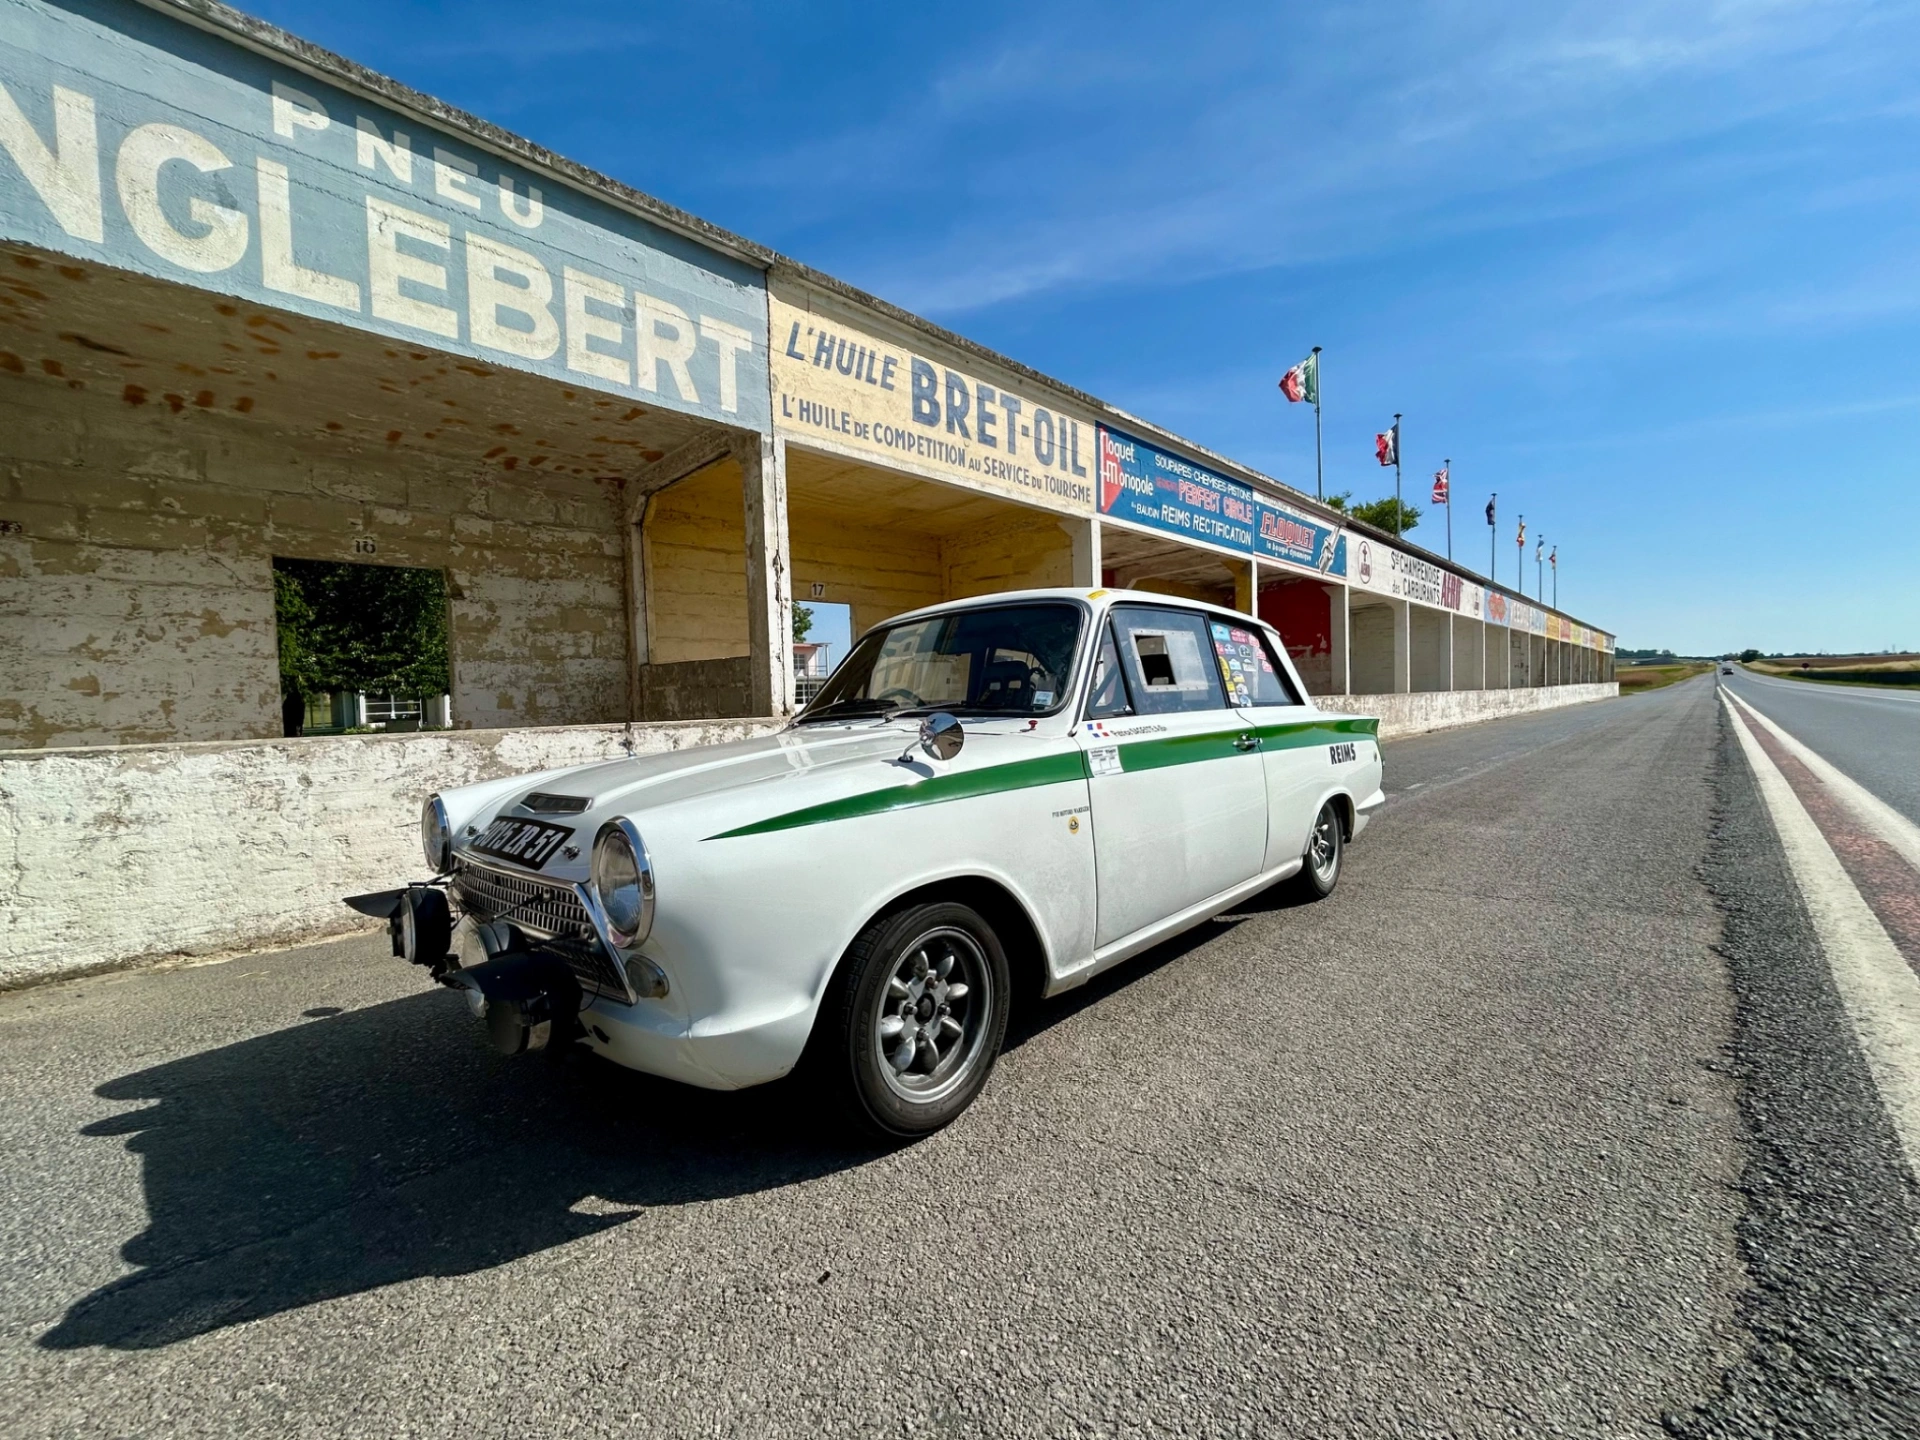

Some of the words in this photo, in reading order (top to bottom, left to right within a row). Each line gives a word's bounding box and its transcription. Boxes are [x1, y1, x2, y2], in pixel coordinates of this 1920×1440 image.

[271, 79, 544, 231] PNEU
[0, 82, 752, 413] NGLEBERT
[785, 320, 899, 391] L'HUILE
[910, 355, 1087, 478] BRET-OIL
[782, 393, 851, 434] L'HUILE
[854, 420, 870, 440] DE
[872, 421, 966, 468] COMPETITION
[968, 457, 982, 473] AU
[983, 456, 1030, 486] SERVICE
[1031, 475, 1042, 490] DU
[1044, 475, 1091, 504] TOURISME
[1178, 478, 1221, 514] PERFECT
[1223, 496, 1253, 525] CIRCLE
[1161, 504, 1191, 528] REIMS
[1192, 514, 1252, 546] RECTIFICATION
[1260, 511, 1316, 550] FLOQUET
[812, 583, 825, 596] 17
[1400, 554, 1440, 586] CHAMPENOISE
[1402, 577, 1440, 606] CARBURANTS
[1329, 742, 1357, 765] REIMS
[502, 824, 541, 855] ZR
[523, 829, 566, 862] 51
